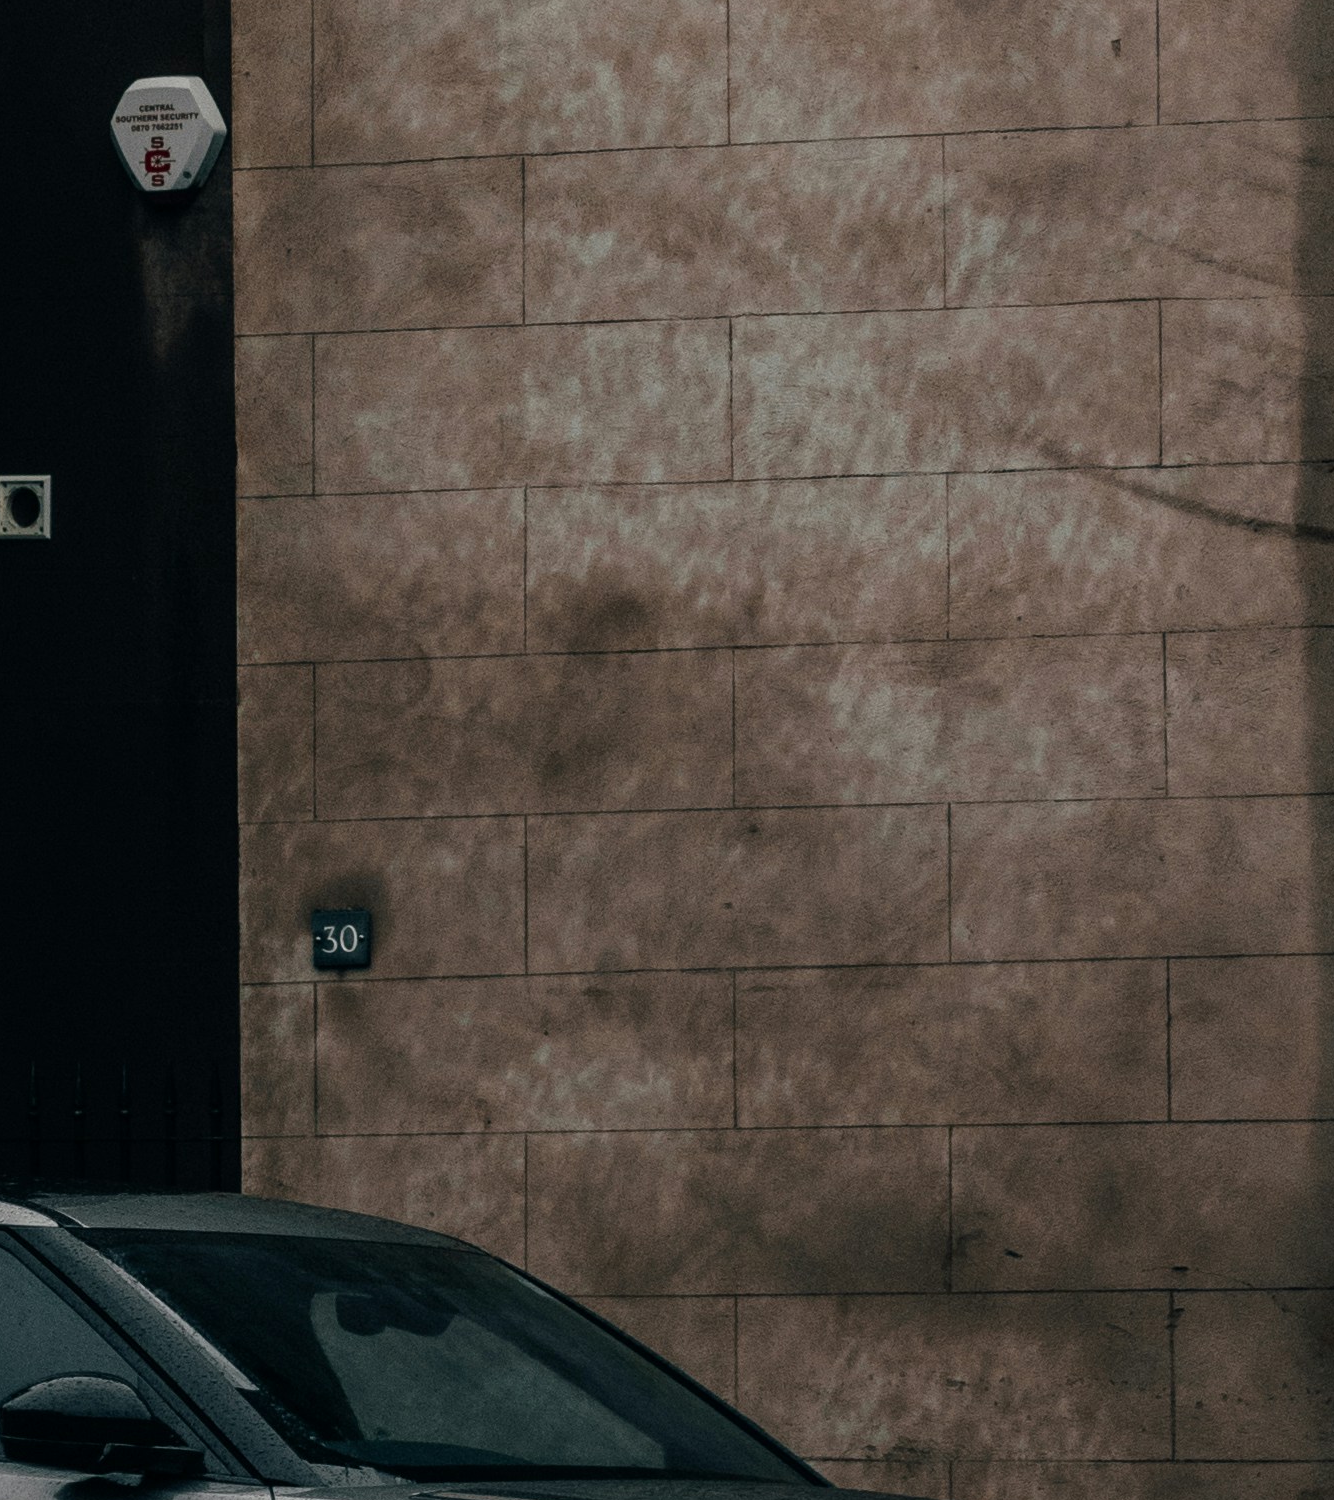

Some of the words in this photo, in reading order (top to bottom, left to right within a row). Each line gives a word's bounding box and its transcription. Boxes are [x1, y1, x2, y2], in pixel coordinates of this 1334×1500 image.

[139, 104, 175, 112] CENTRAL
[115, 114, 158, 123] SOUTHERN
[160, 113, 199, 121] SECURITY
[321, 924, 358, 954] 30
